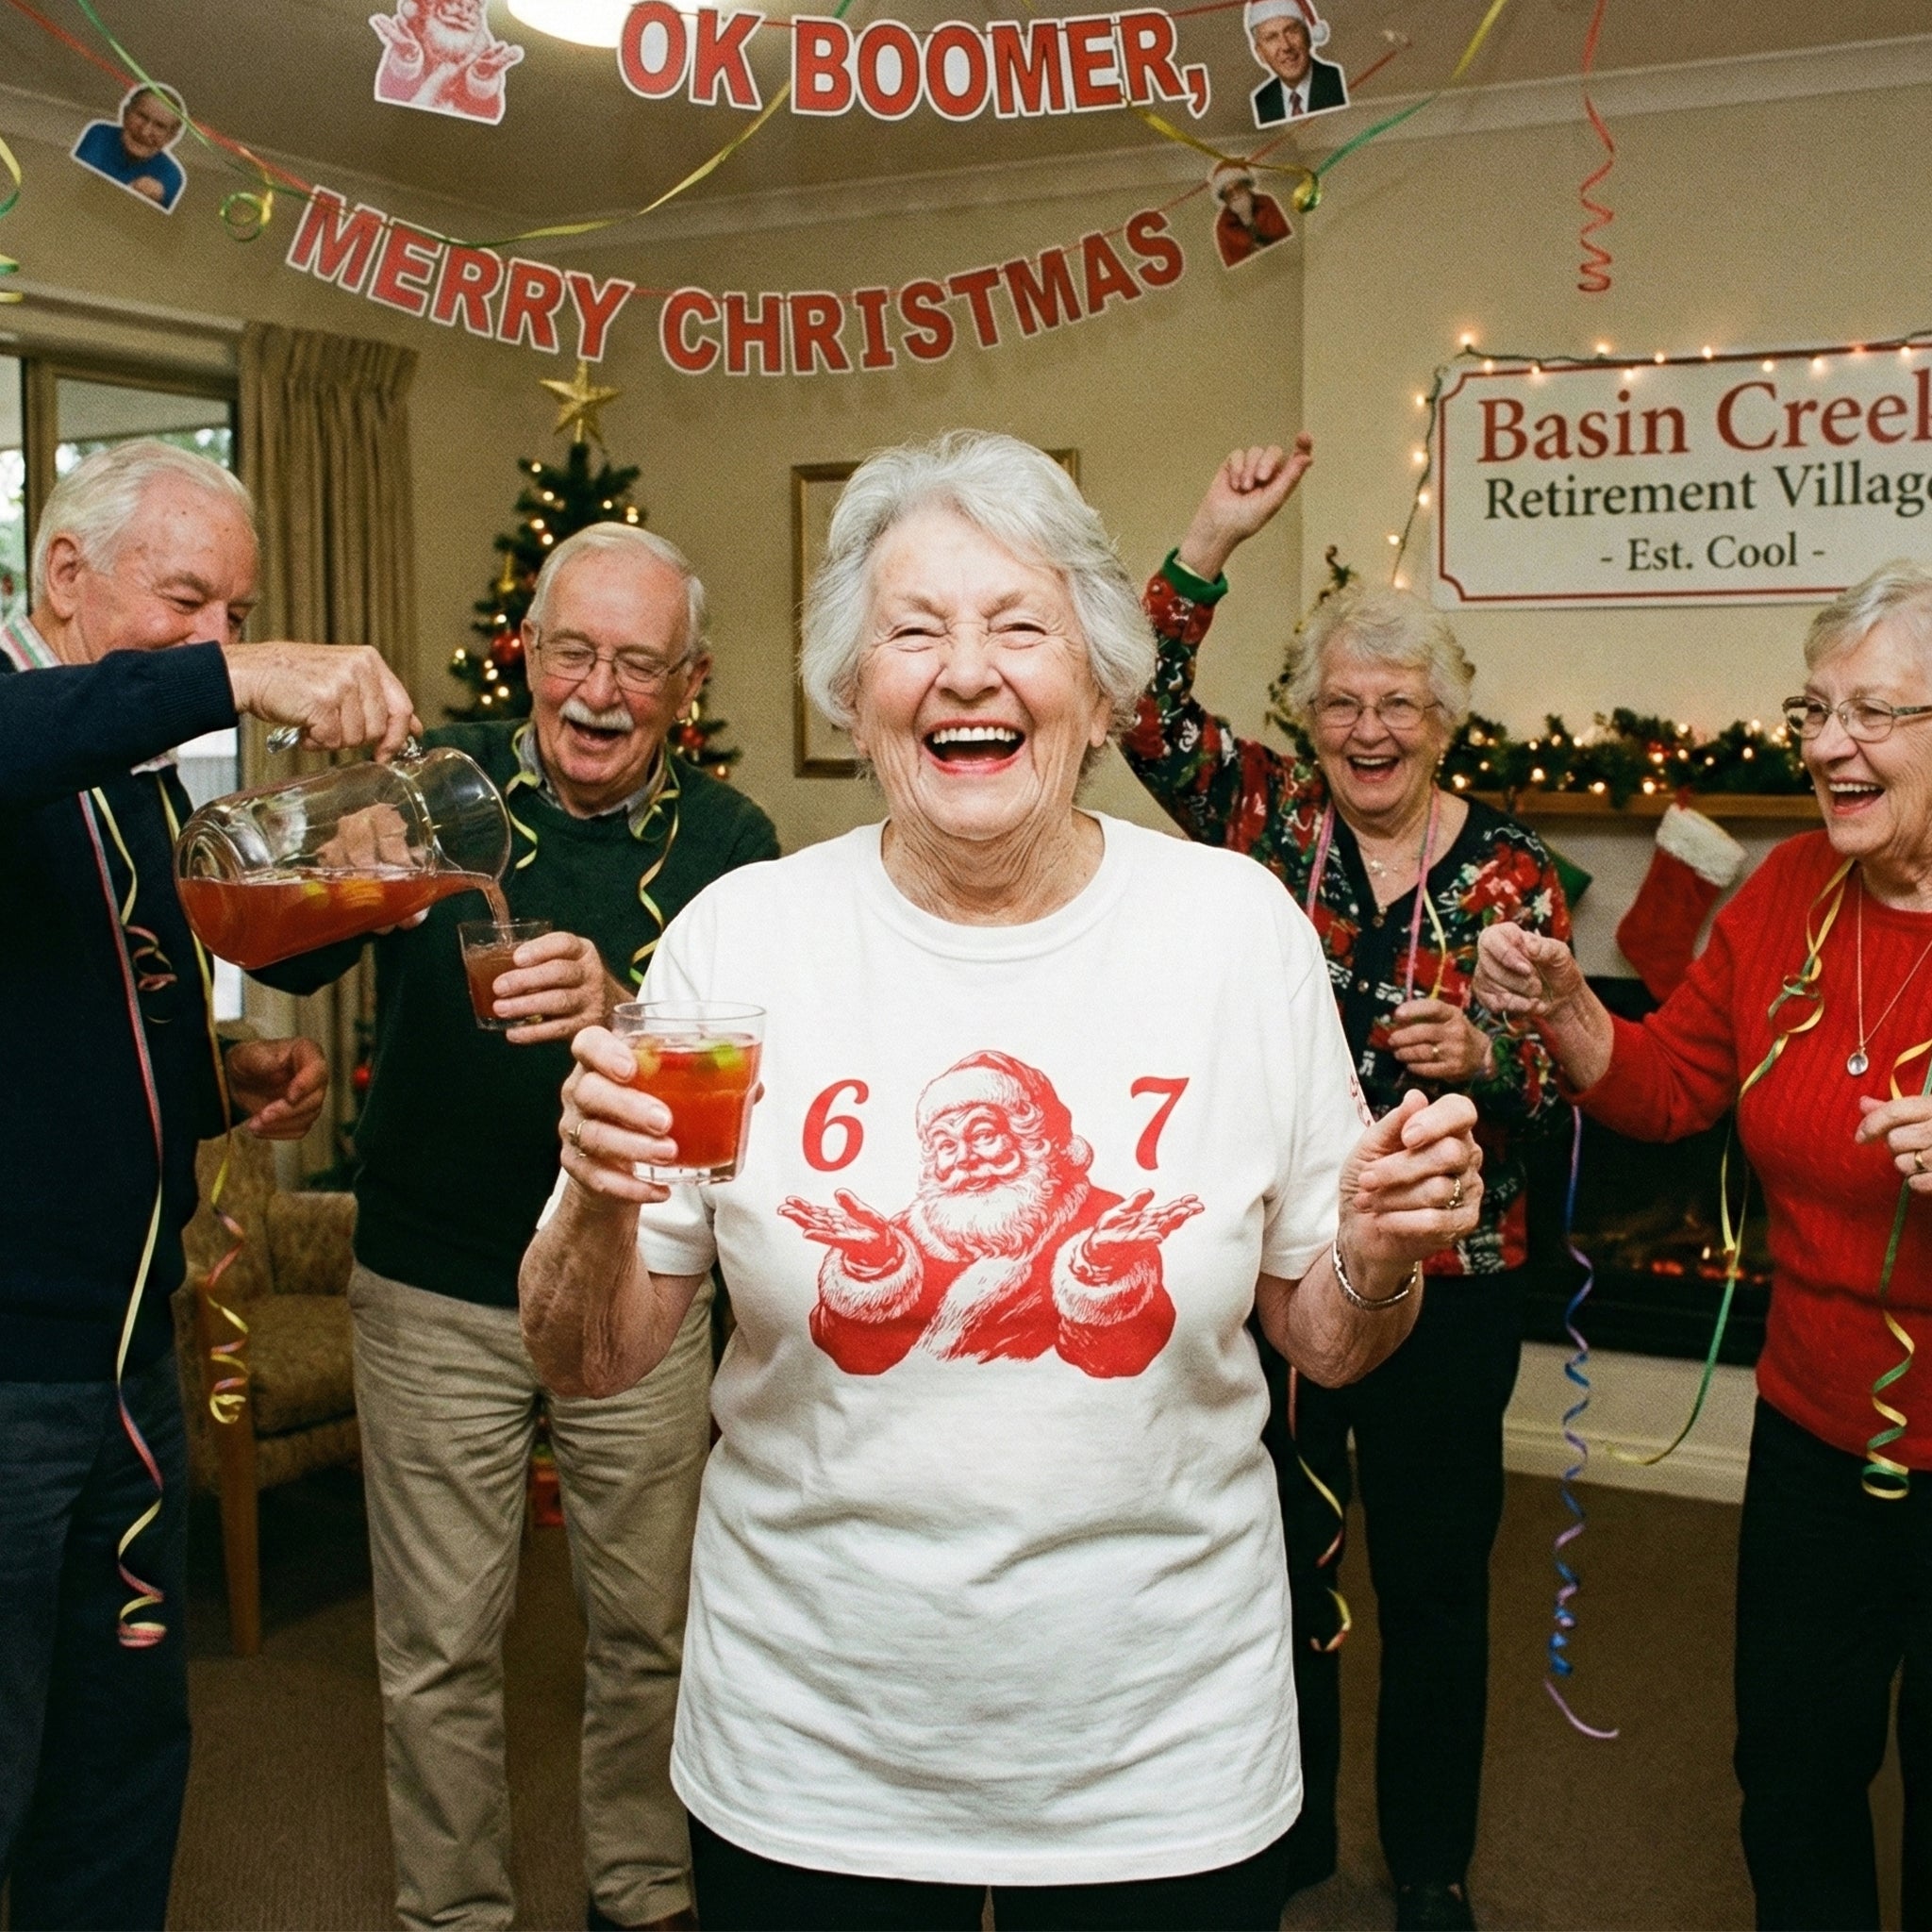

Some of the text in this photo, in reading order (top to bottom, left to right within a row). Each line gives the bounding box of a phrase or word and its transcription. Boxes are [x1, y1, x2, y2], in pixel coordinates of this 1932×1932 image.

[618, 0, 1210, 119] OK BOOMER,
[286, 185, 1185, 375] MERRY CHRISTMAS
[1476, 389, 1688, 463] Basin
[1484, 458, 1932, 520] Retirement Villag
[1627, 538, 1694, 572] Est.
[1706, 531, 1799, 569] Cool
[802, 1076, 1190, 1172] 6 7
